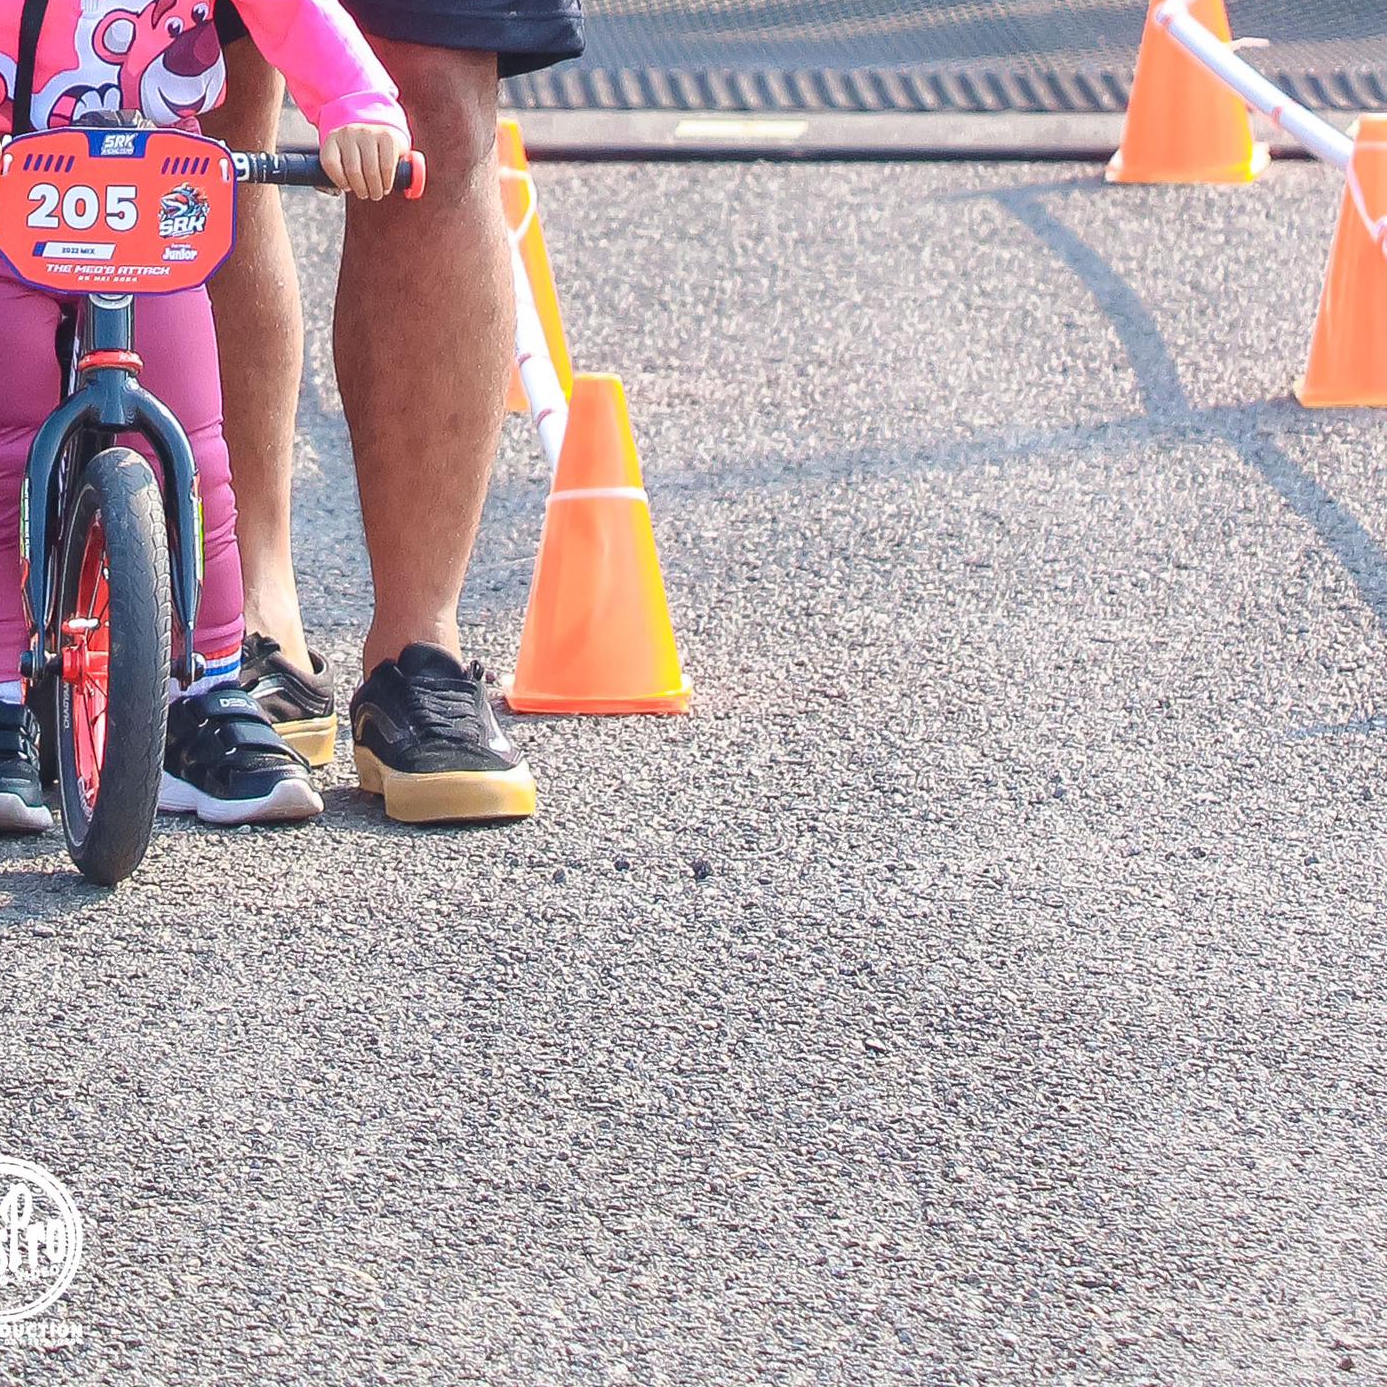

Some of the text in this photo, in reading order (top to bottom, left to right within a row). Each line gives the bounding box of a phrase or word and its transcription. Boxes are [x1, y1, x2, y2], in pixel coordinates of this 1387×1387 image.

[103, 133, 137, 148] SRK
[26, 183, 139, 231] 205
[158, 215, 206, 236] SRK
[162, 247, 198, 260] Junior
[46, 263, 72, 273] THE
[117, 266, 171, 276] ATTACK
